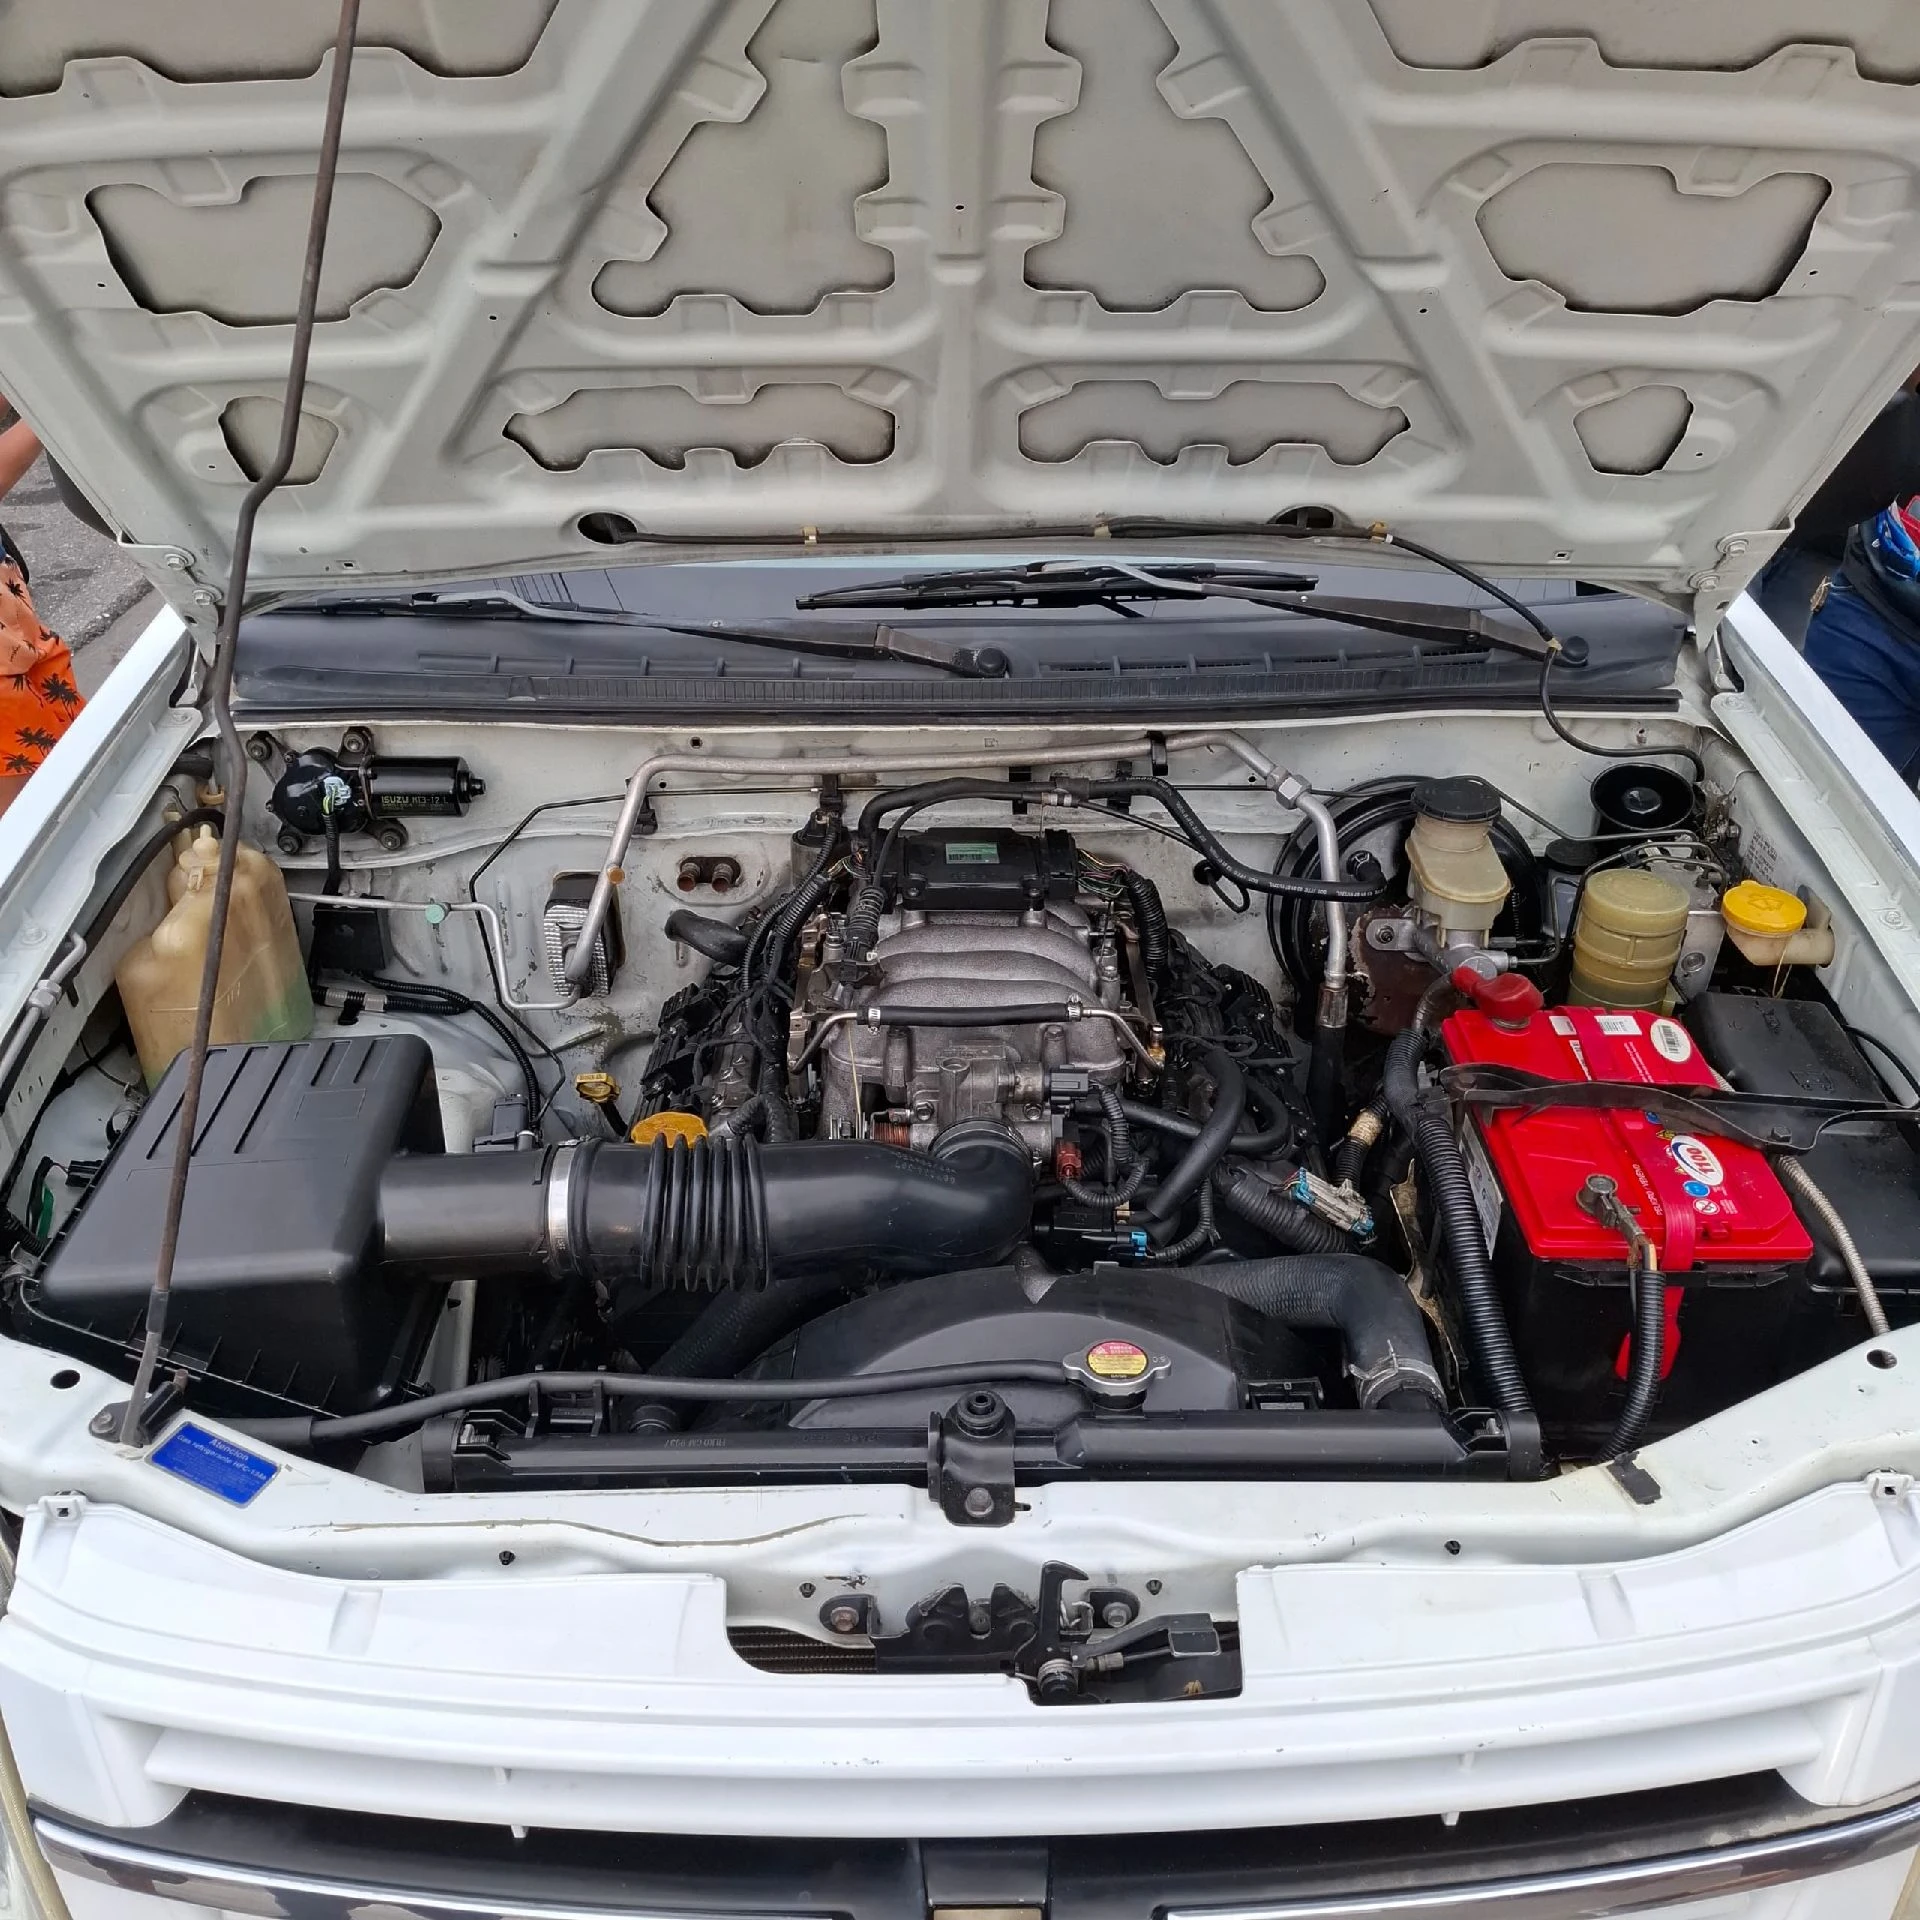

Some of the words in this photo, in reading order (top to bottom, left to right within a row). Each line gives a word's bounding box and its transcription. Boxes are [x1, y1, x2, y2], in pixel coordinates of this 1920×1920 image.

[381, 796, 410, 804] ISUZU
[1686, 1147, 1715, 1175] 1100
[177, 1434, 192, 1444] Gas
